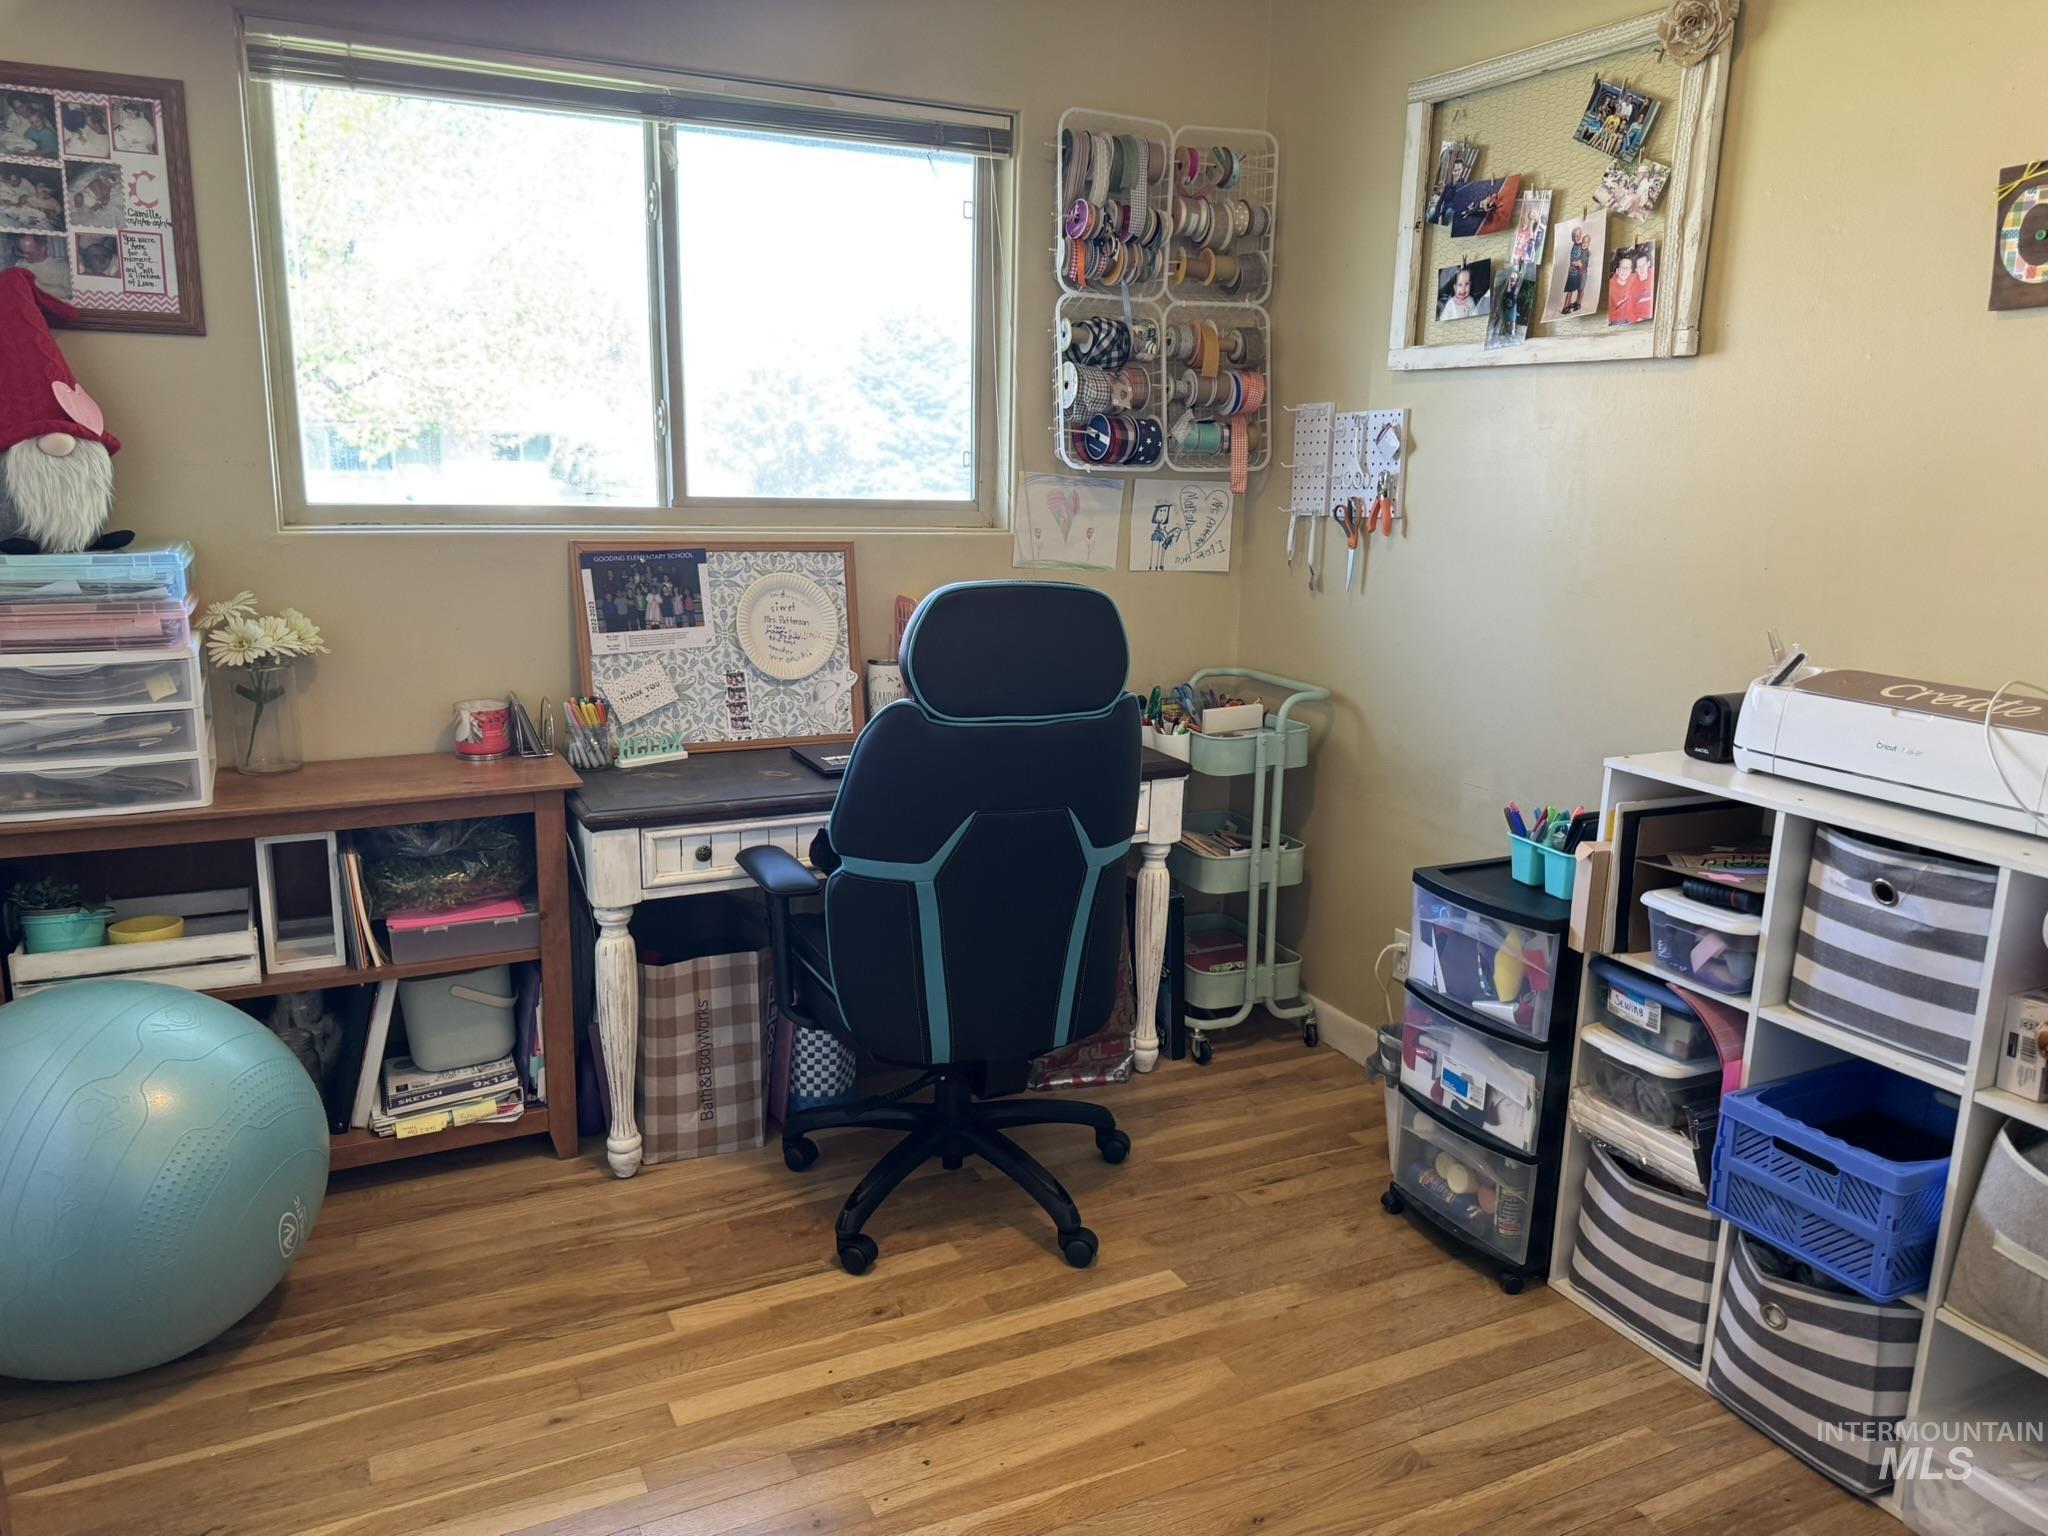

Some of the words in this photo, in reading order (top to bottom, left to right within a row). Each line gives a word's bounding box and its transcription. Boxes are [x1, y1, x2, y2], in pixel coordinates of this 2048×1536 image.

[127, 208, 162, 220] Camille
[667, 551, 694, 560] SCHOOL
[619, 689, 643, 704] THANK
[644, 681, 661, 692] YOU
[1880, 684, 2043, 718] Create
[618, 730, 684, 761] RELAX
[1876, 741, 1897, 752] Cricut
[1614, 994, 1644, 1017] Sewing
[398, 1090, 443, 1105] SKETCH
